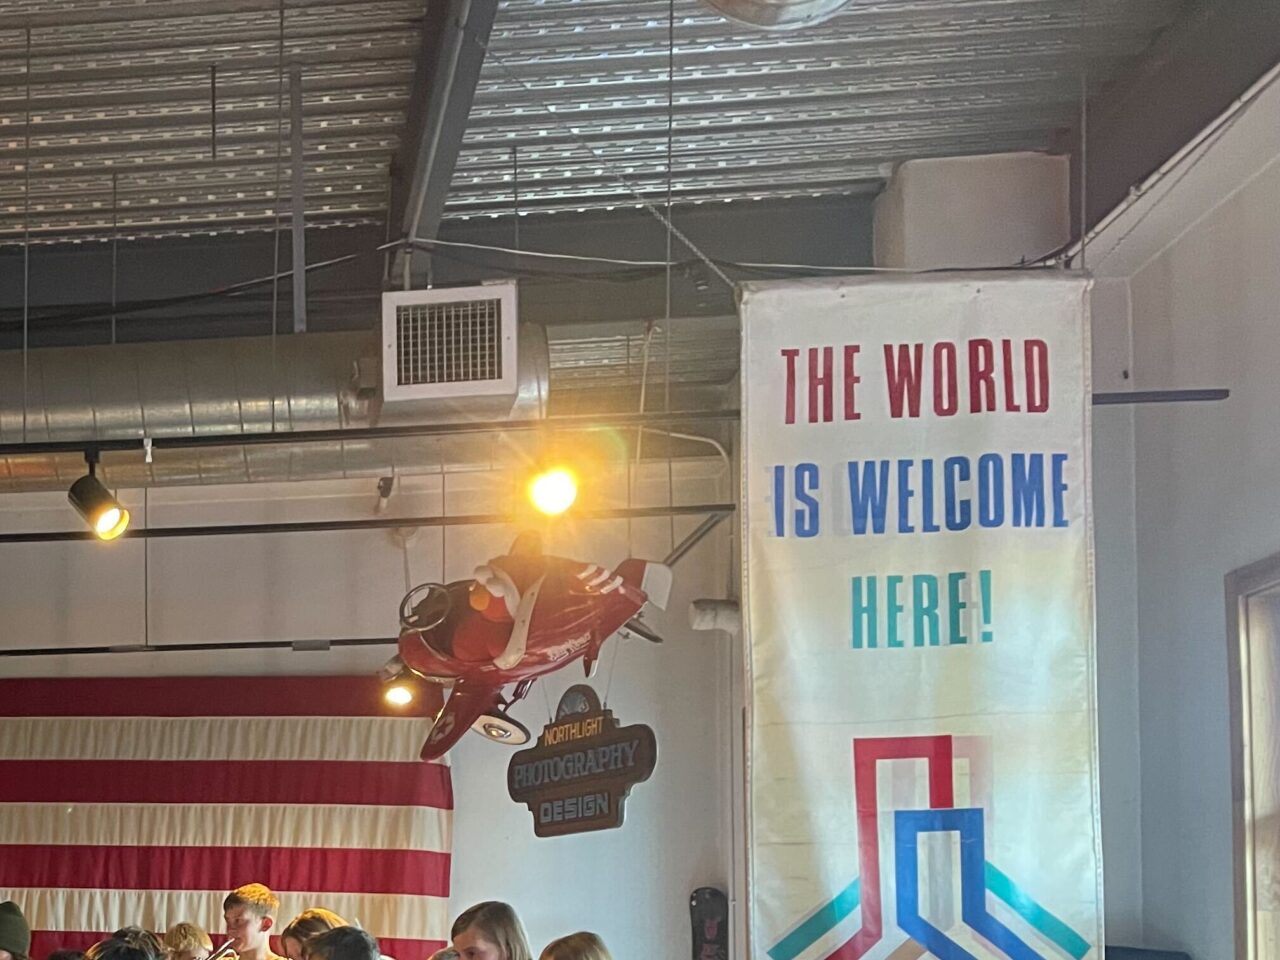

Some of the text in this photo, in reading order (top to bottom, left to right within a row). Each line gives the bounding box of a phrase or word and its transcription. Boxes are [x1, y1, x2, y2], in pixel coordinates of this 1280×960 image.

[781, 338, 1049, 424] THE WORLD
[774, 453, 1069, 538] IS WELCOME
[851, 569, 993, 649] HERE!
[544, 716, 604, 746] NORTHLIGHT
[513, 740, 639, 788] PHOTOGRAPHY
[540, 793, 609, 823] DESIGN
